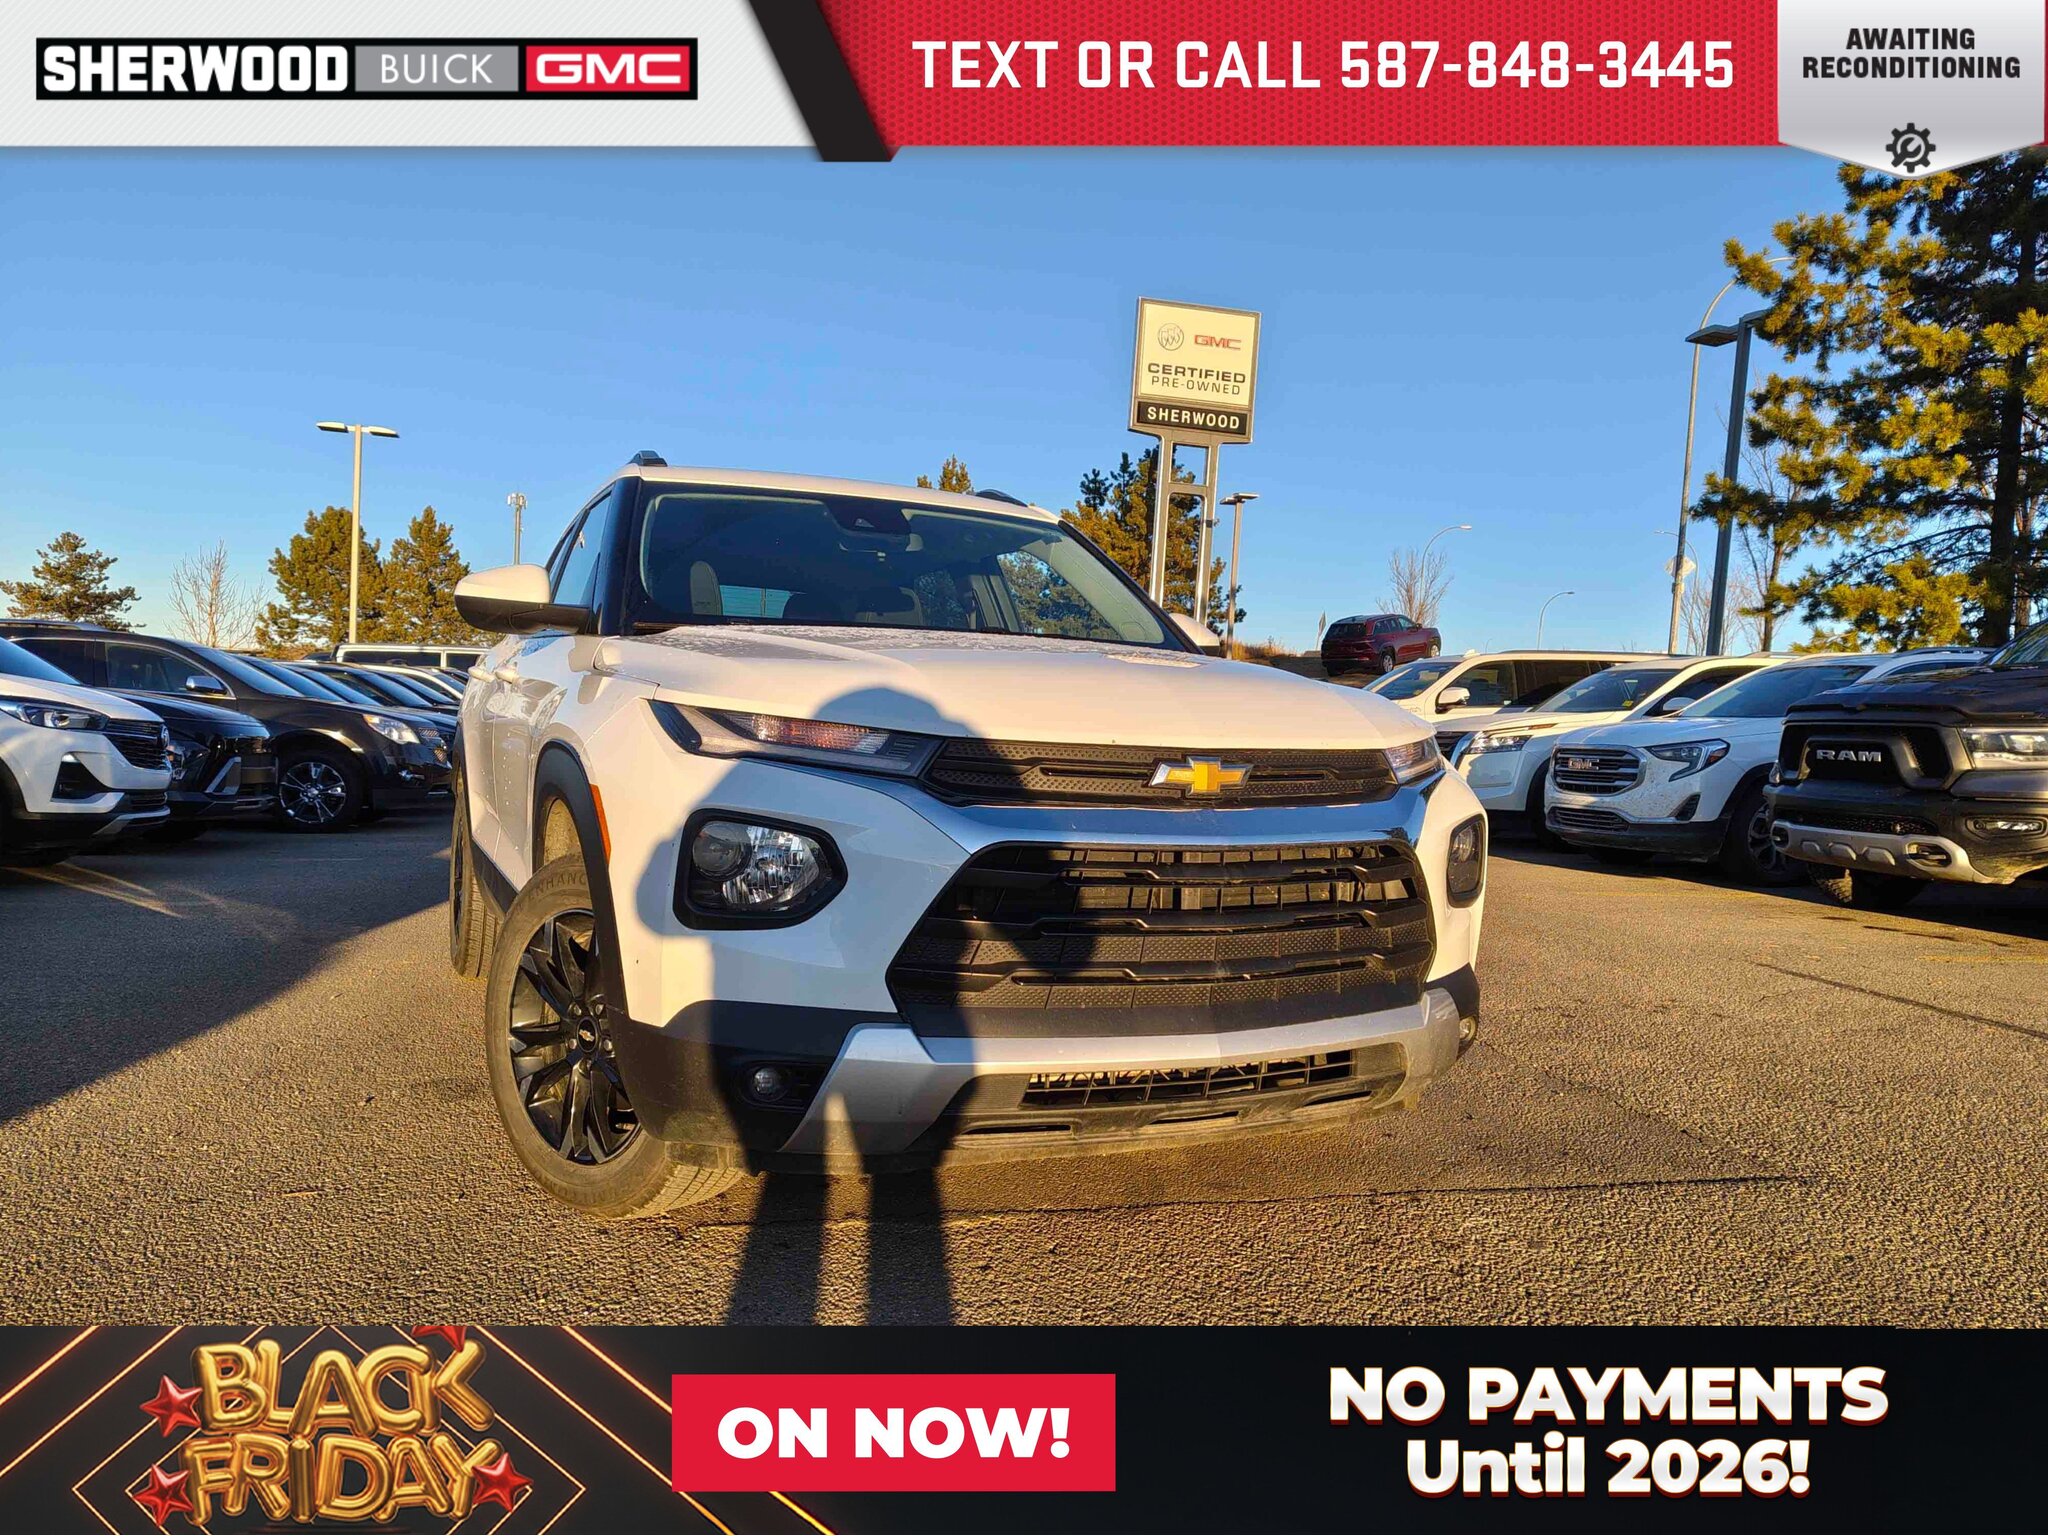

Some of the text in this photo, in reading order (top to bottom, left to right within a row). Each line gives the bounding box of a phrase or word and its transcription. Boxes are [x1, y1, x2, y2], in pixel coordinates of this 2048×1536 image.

[1194, 334, 1242, 351] GMC
[1147, 362, 1246, 384] CERTIFIED
[1151, 375, 1241, 396] PRE-OWNED
[1147, 406, 1240, 429] SHERWOOD
[1568, 757, 1600, 771] GMC
[1816, 749, 1881, 762] RAM
